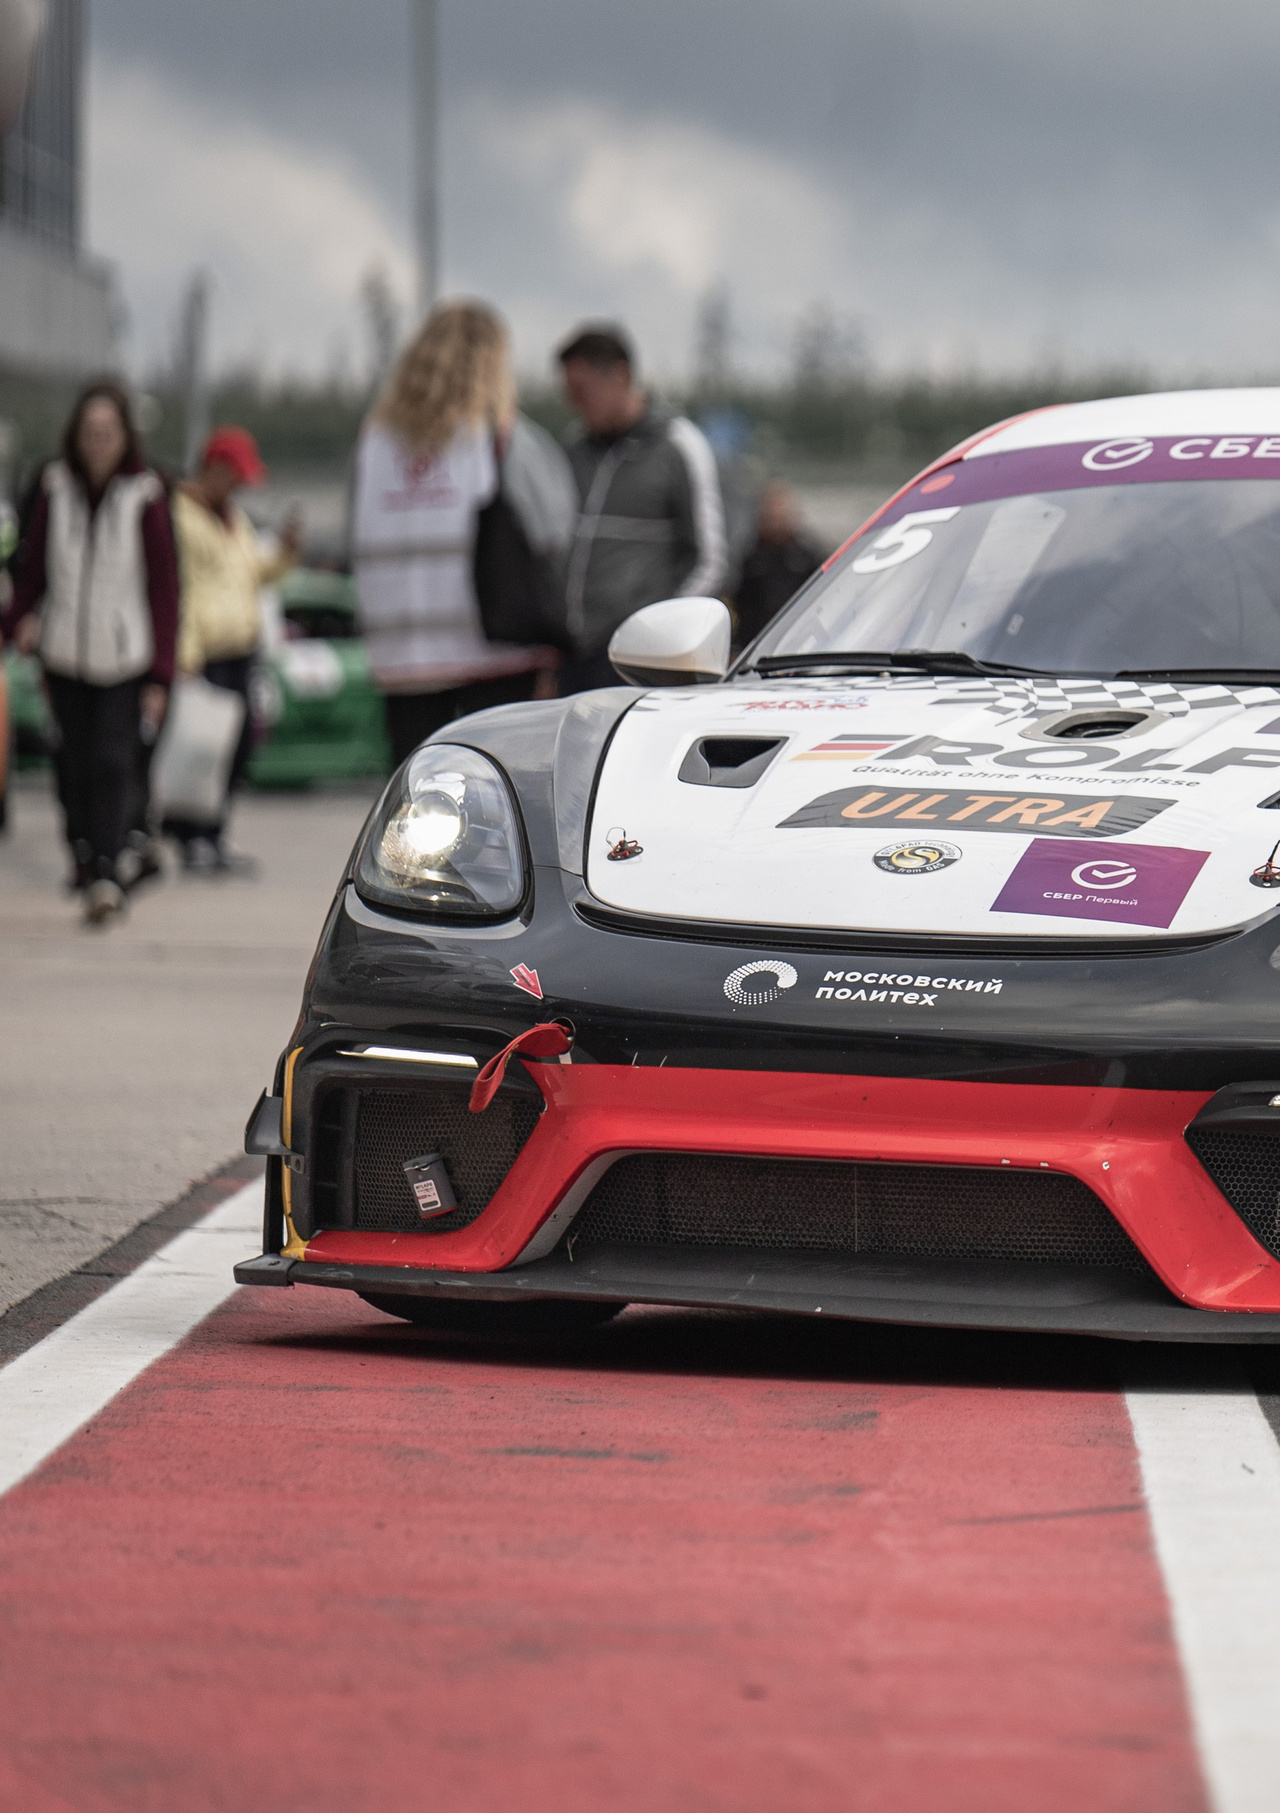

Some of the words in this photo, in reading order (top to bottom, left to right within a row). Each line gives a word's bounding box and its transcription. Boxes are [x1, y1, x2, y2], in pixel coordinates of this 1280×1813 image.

[852, 506, 961, 574] 5
[852, 765, 953, 778] Qualität
[958, 770, 1019, 780] ohne
[1026, 772, 1201, 787] Kompromisse
[841, 792, 1115, 828] ULTRA
[1042, 891, 1083, 900] СБЕР
[1085, 895, 1139, 906] Первый
